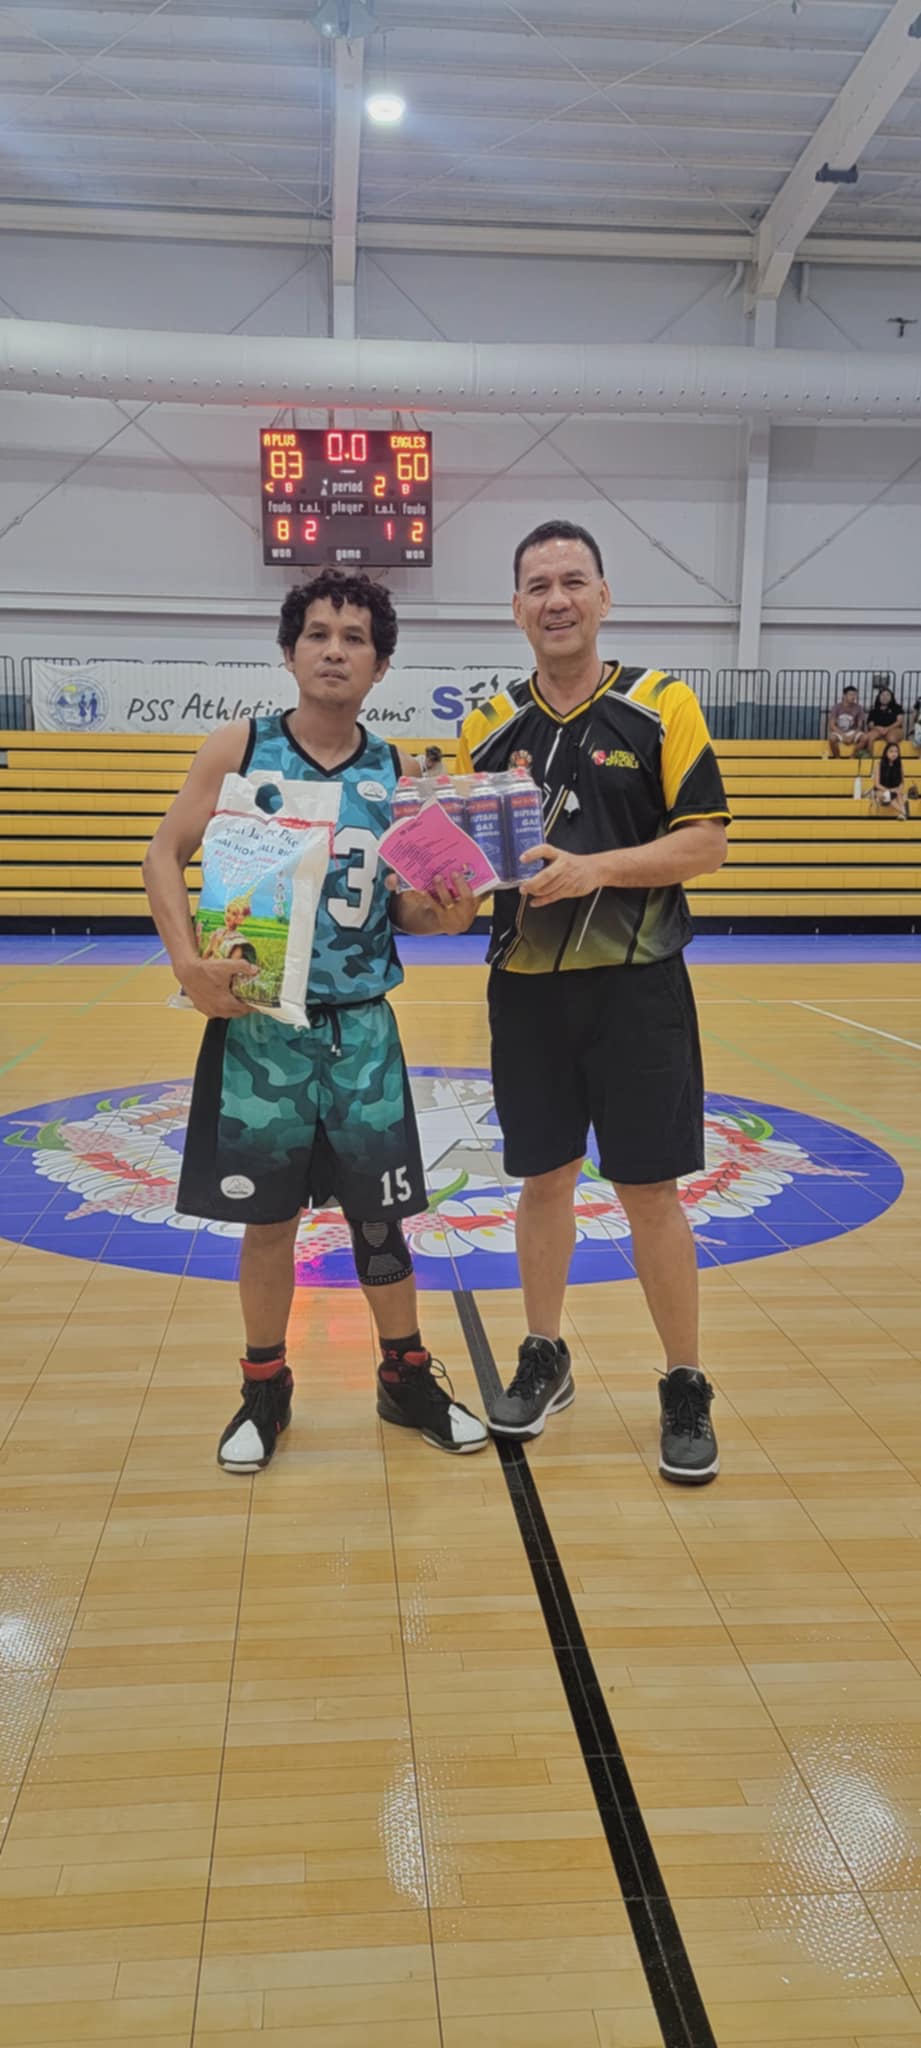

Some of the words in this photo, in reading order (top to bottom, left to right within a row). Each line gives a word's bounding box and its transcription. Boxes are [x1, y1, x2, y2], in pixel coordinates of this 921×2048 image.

[272, 433, 297, 447] PLUS
[327, 433, 367, 461] 0.0
[390, 436, 426, 448] EAGLES
[271, 451, 303, 479] 83
[397, 453, 430, 481] 60
[332, 480, 363, 495] period
[374, 476, 386, 496] 2
[268, 500, 292, 512] fouls
[331, 500, 364, 515] player
[402, 502, 426, 515] fouls
[277, 519, 290, 541] 8
[304, 519, 317, 541] 2
[386, 522, 393, 541] 1
[411, 521, 423, 542] 2
[271, 548, 291, 558] won
[335, 549, 361, 561] game
[405, 549, 425, 560] won
[127, 698, 174, 722] PSS
[381, 1165, 412, 1206] 15
